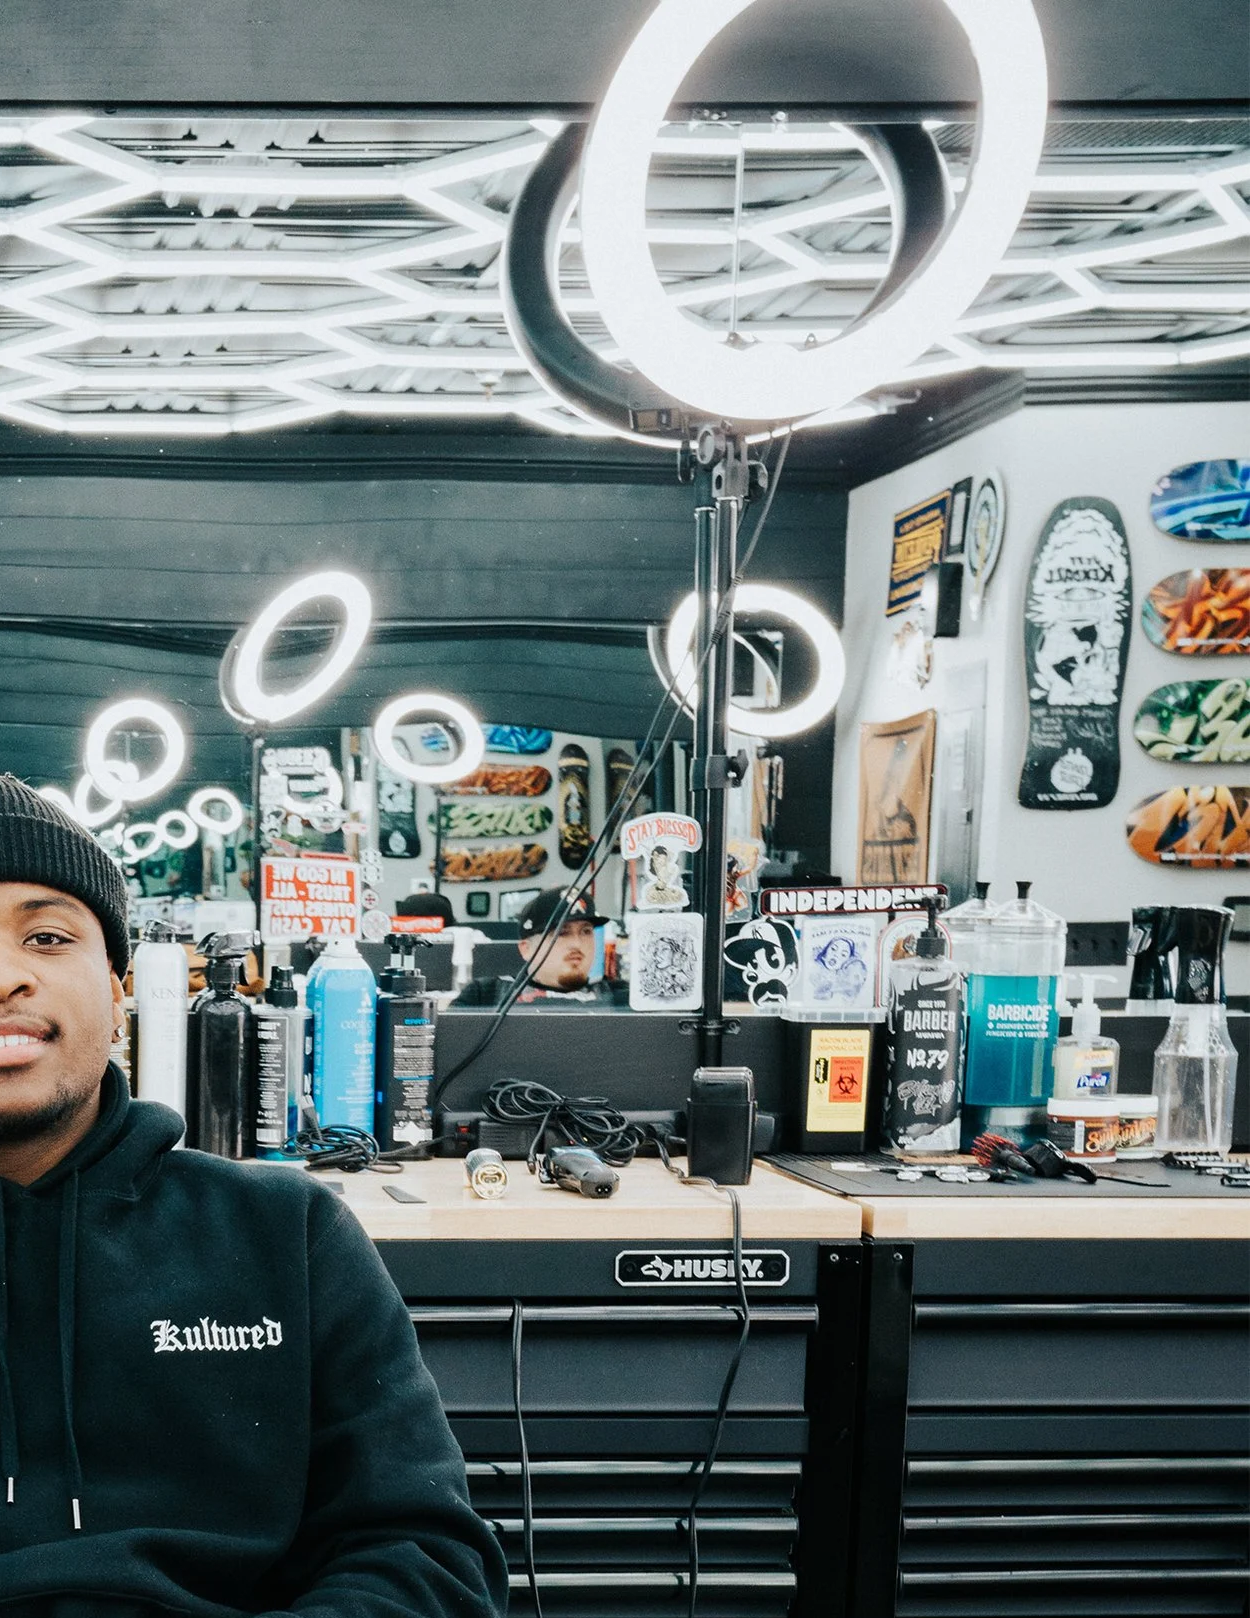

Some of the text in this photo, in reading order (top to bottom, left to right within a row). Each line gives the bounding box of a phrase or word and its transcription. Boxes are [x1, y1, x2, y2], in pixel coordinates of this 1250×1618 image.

[628, 820, 653, 851] STAY
[903, 1010, 957, 1032] BARBER
[150, 1316, 283, 1353] Kultured
